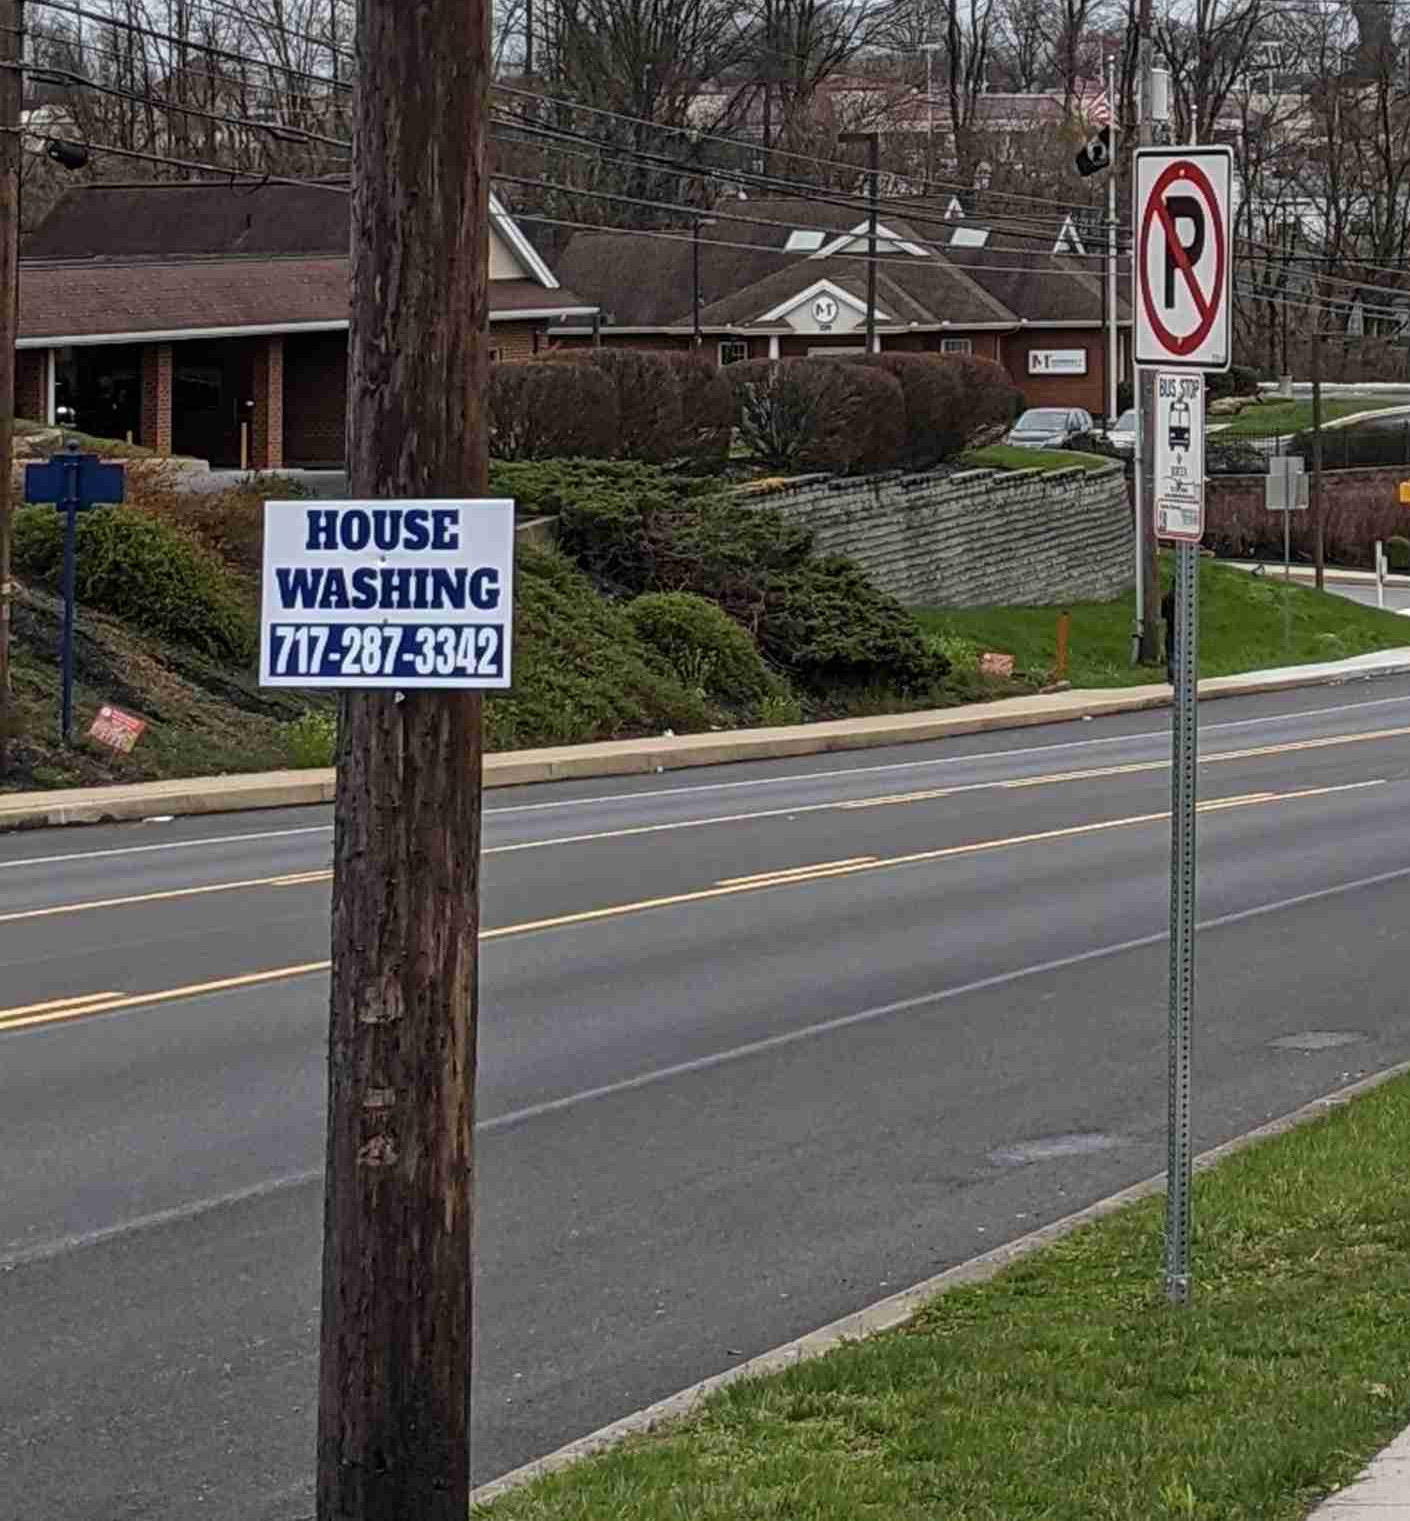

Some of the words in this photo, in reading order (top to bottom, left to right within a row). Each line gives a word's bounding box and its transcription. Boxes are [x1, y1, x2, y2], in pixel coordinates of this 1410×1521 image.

[1159, 378, 1176, 398] BUS
[1179, 378, 1200, 399] STOP
[305, 509, 460, 551] HOUSE
[275, 567, 501, 610] WASHING
[274, 626, 499, 675] 717-287-3342
